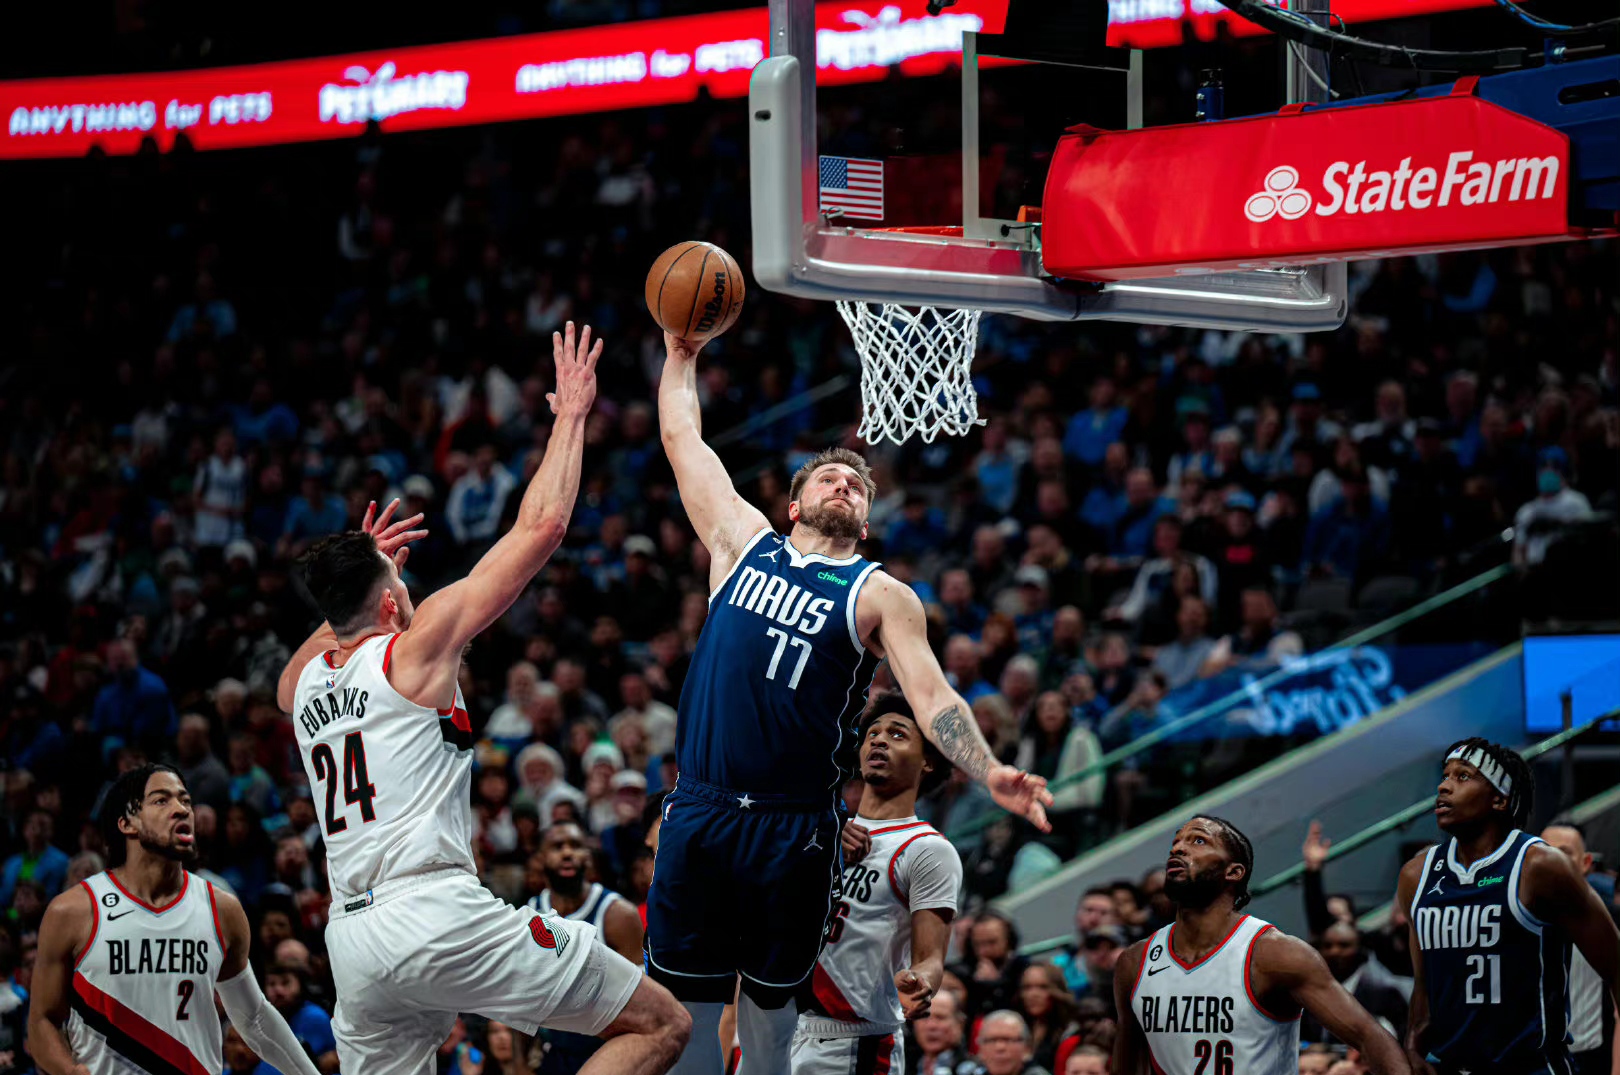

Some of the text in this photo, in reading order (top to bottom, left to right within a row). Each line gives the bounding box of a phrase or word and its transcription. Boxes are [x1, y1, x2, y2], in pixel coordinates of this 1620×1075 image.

[9, 92, 272, 135] ANYTHING for PETS
[817, 570, 848, 586] chime
[728, 565, 835, 635] MAVS
[765, 626, 813, 690] 77
[300, 687, 369, 740] EUBANKS
[311, 730, 377, 836] 24
[1434, 859, 1444, 871] 6
[1477, 875, 1504, 888] chime
[104, 893, 118, 907] 6
[1417, 904, 1502, 950] MAVS
[105, 938, 209, 975] BLAZERS
[1150, 945, 1162, 961] 6
[1466, 954, 1502, 1004] 21
[176, 979, 195, 1021] 2
[1141, 995, 1235, 1034] BLAZERS
[1194, 1039, 1234, 1075] 26
